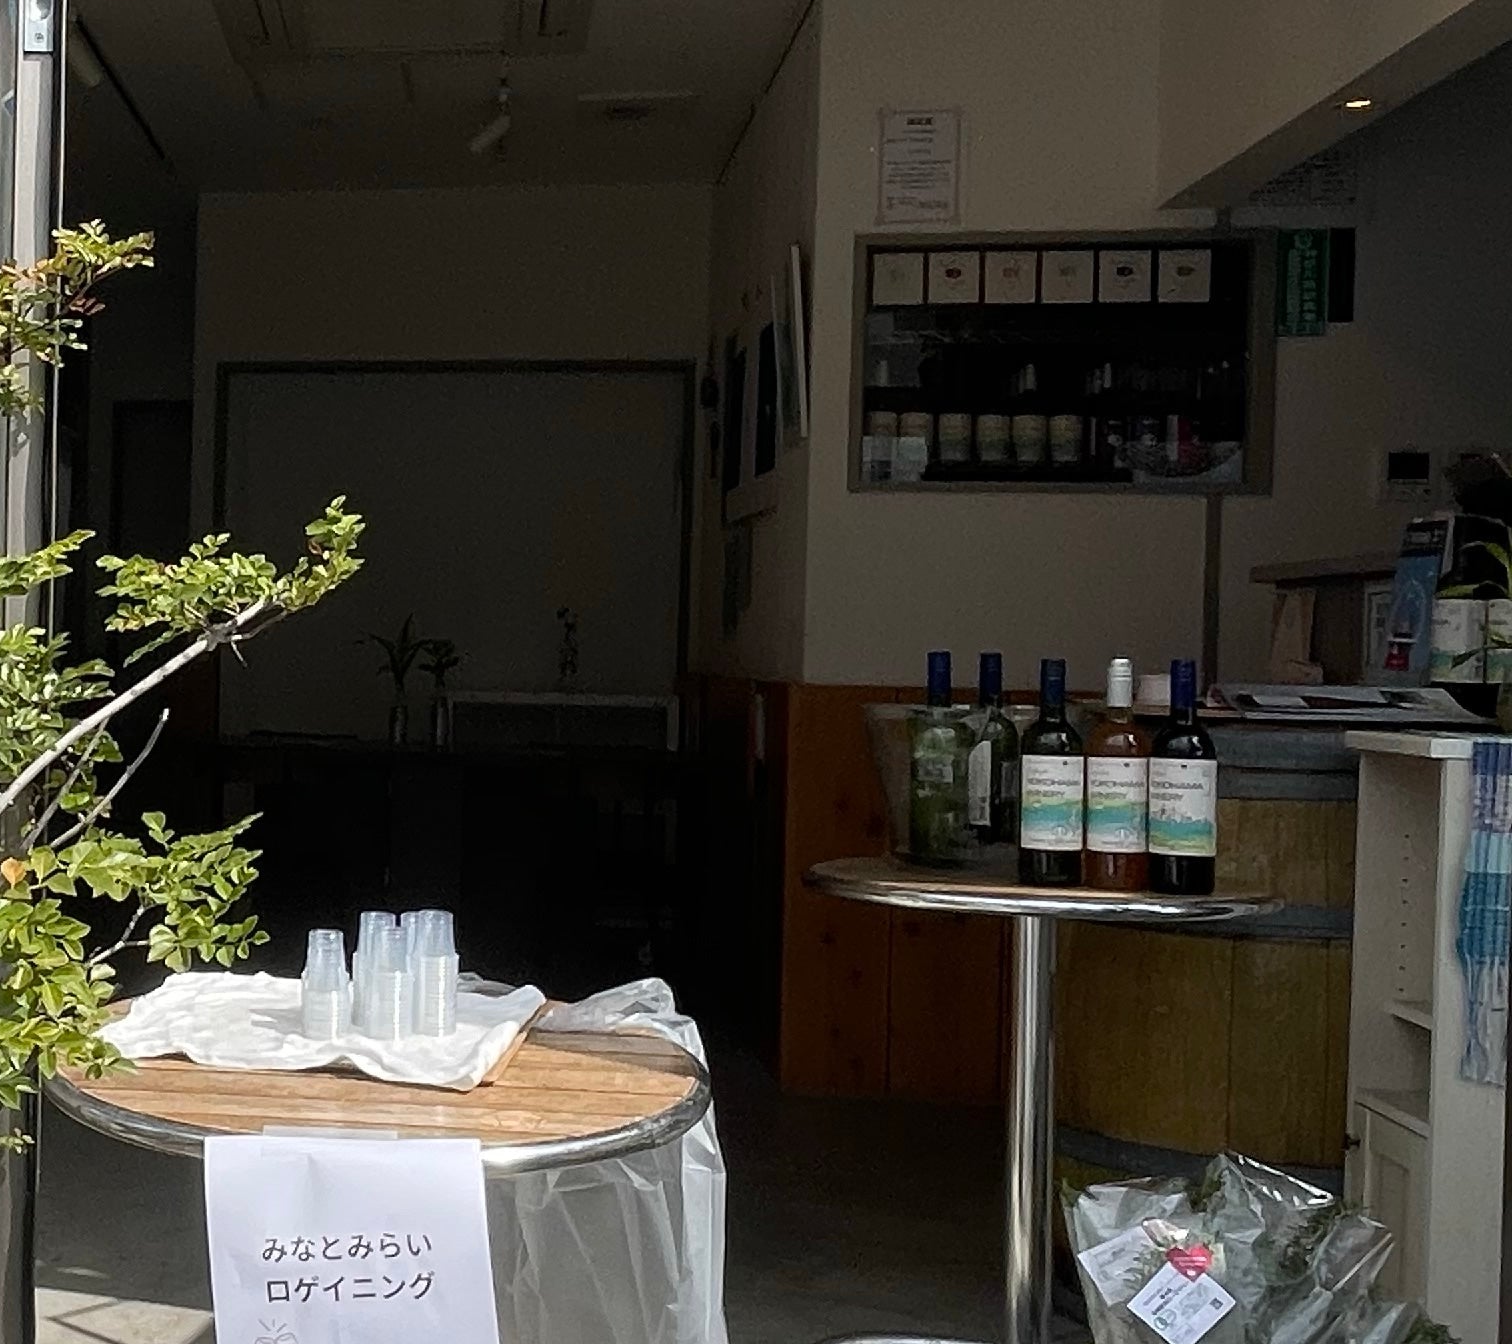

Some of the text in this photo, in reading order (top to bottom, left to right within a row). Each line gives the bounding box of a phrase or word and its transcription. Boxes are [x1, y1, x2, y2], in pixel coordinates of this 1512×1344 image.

[261, 1232, 433, 1263] みなとみらい
[266, 1270, 436, 1305] ロゲイニング
